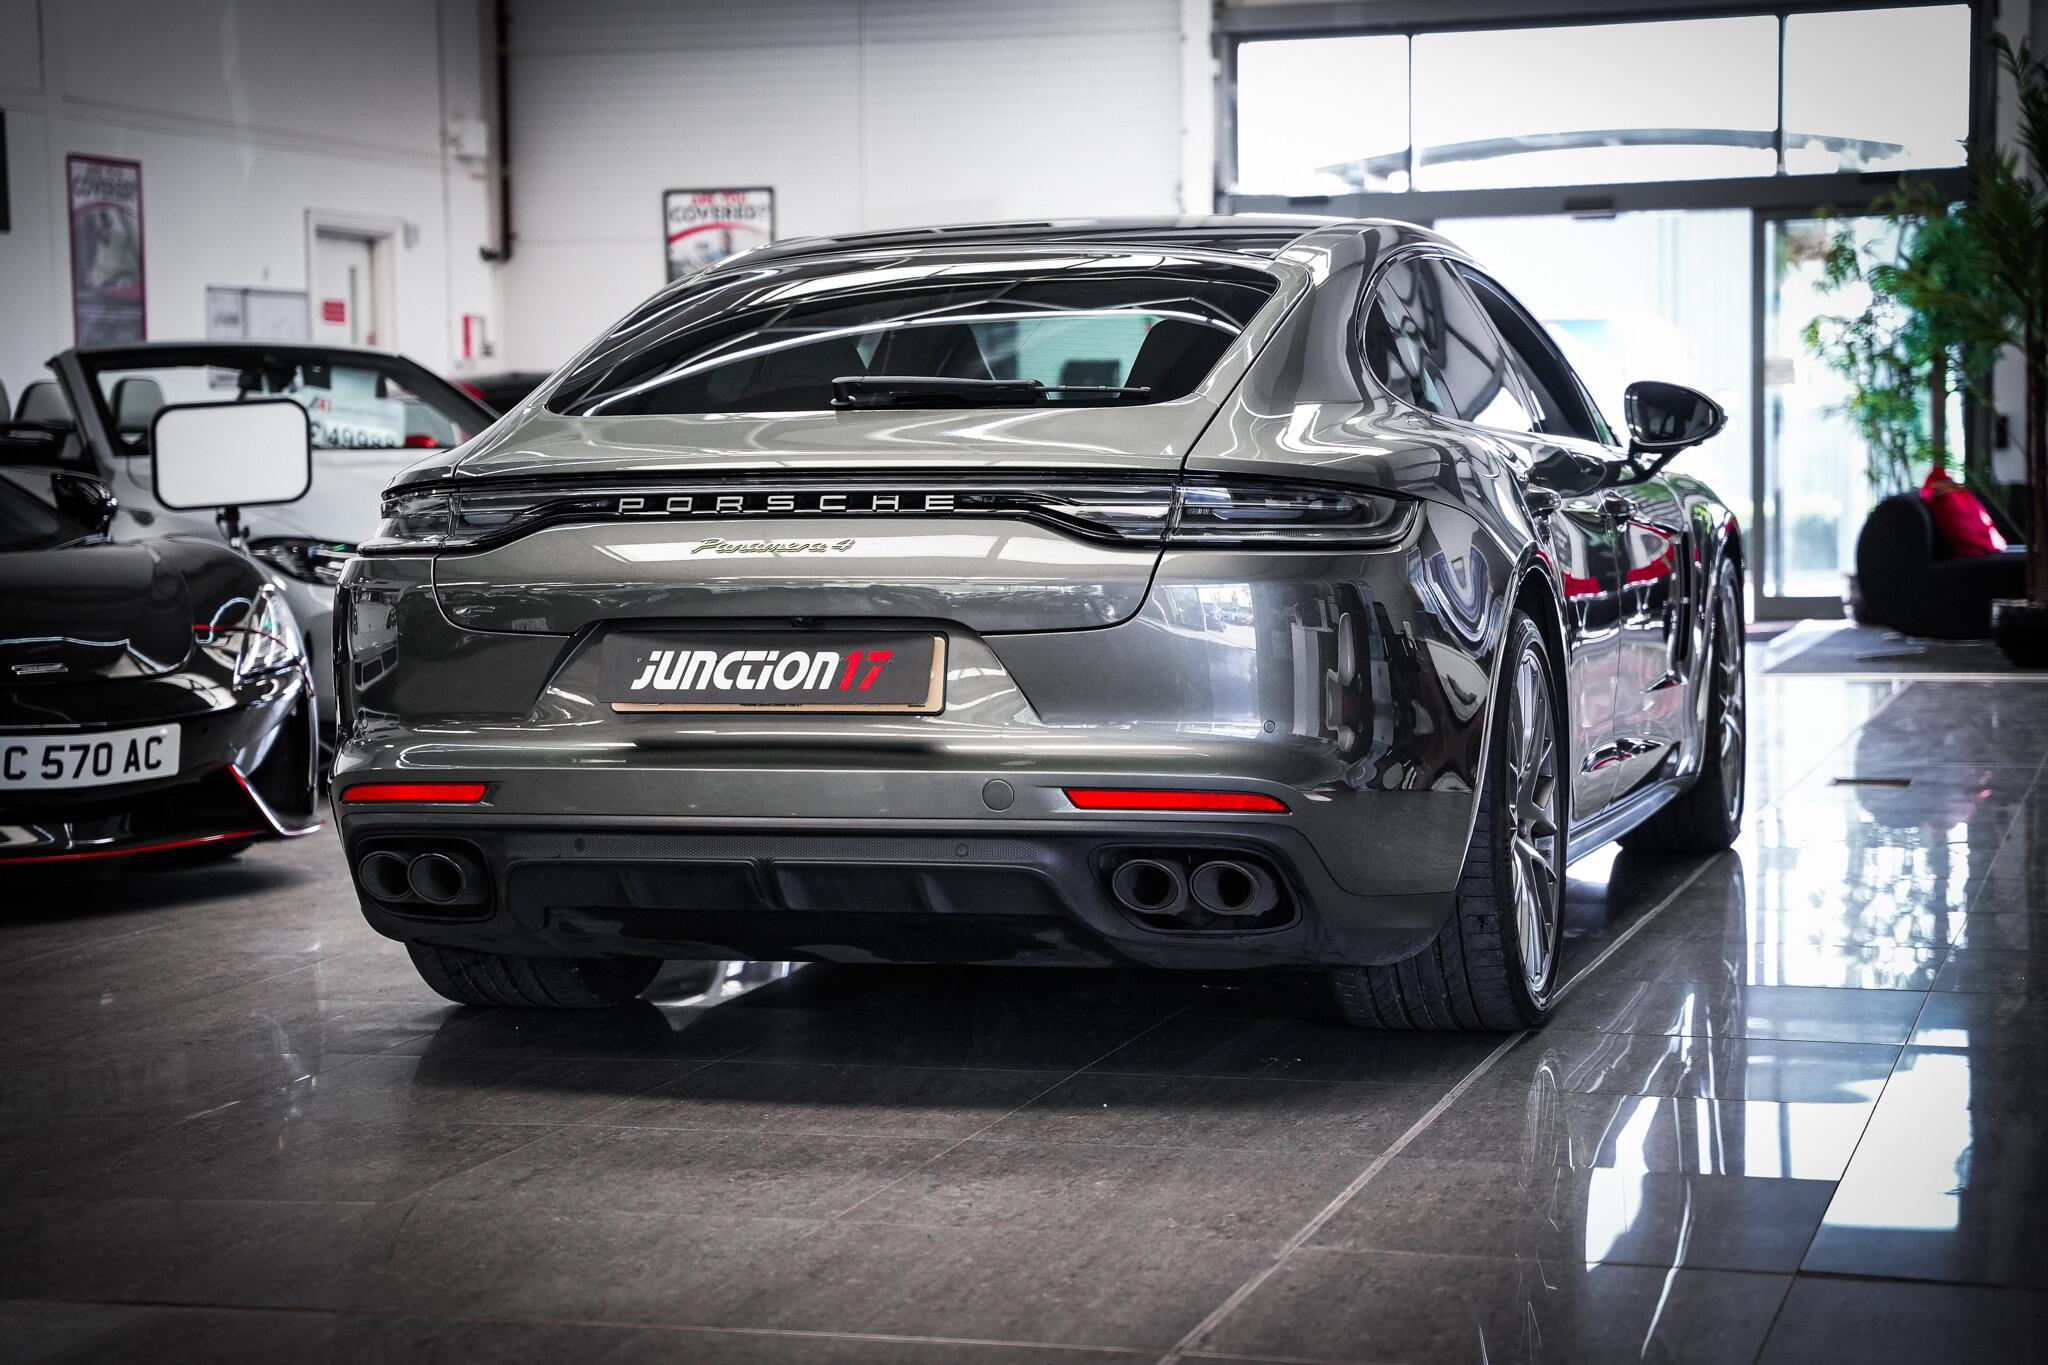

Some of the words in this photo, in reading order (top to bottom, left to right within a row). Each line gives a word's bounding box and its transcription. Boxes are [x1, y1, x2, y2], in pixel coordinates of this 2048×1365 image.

[618, 495, 955, 514] PORSCHE
[690, 537, 828, 554] Panamera
[832, 538, 856, 552] 4
[40, 741, 114, 780] 570
[123, 735, 163, 774] AC
